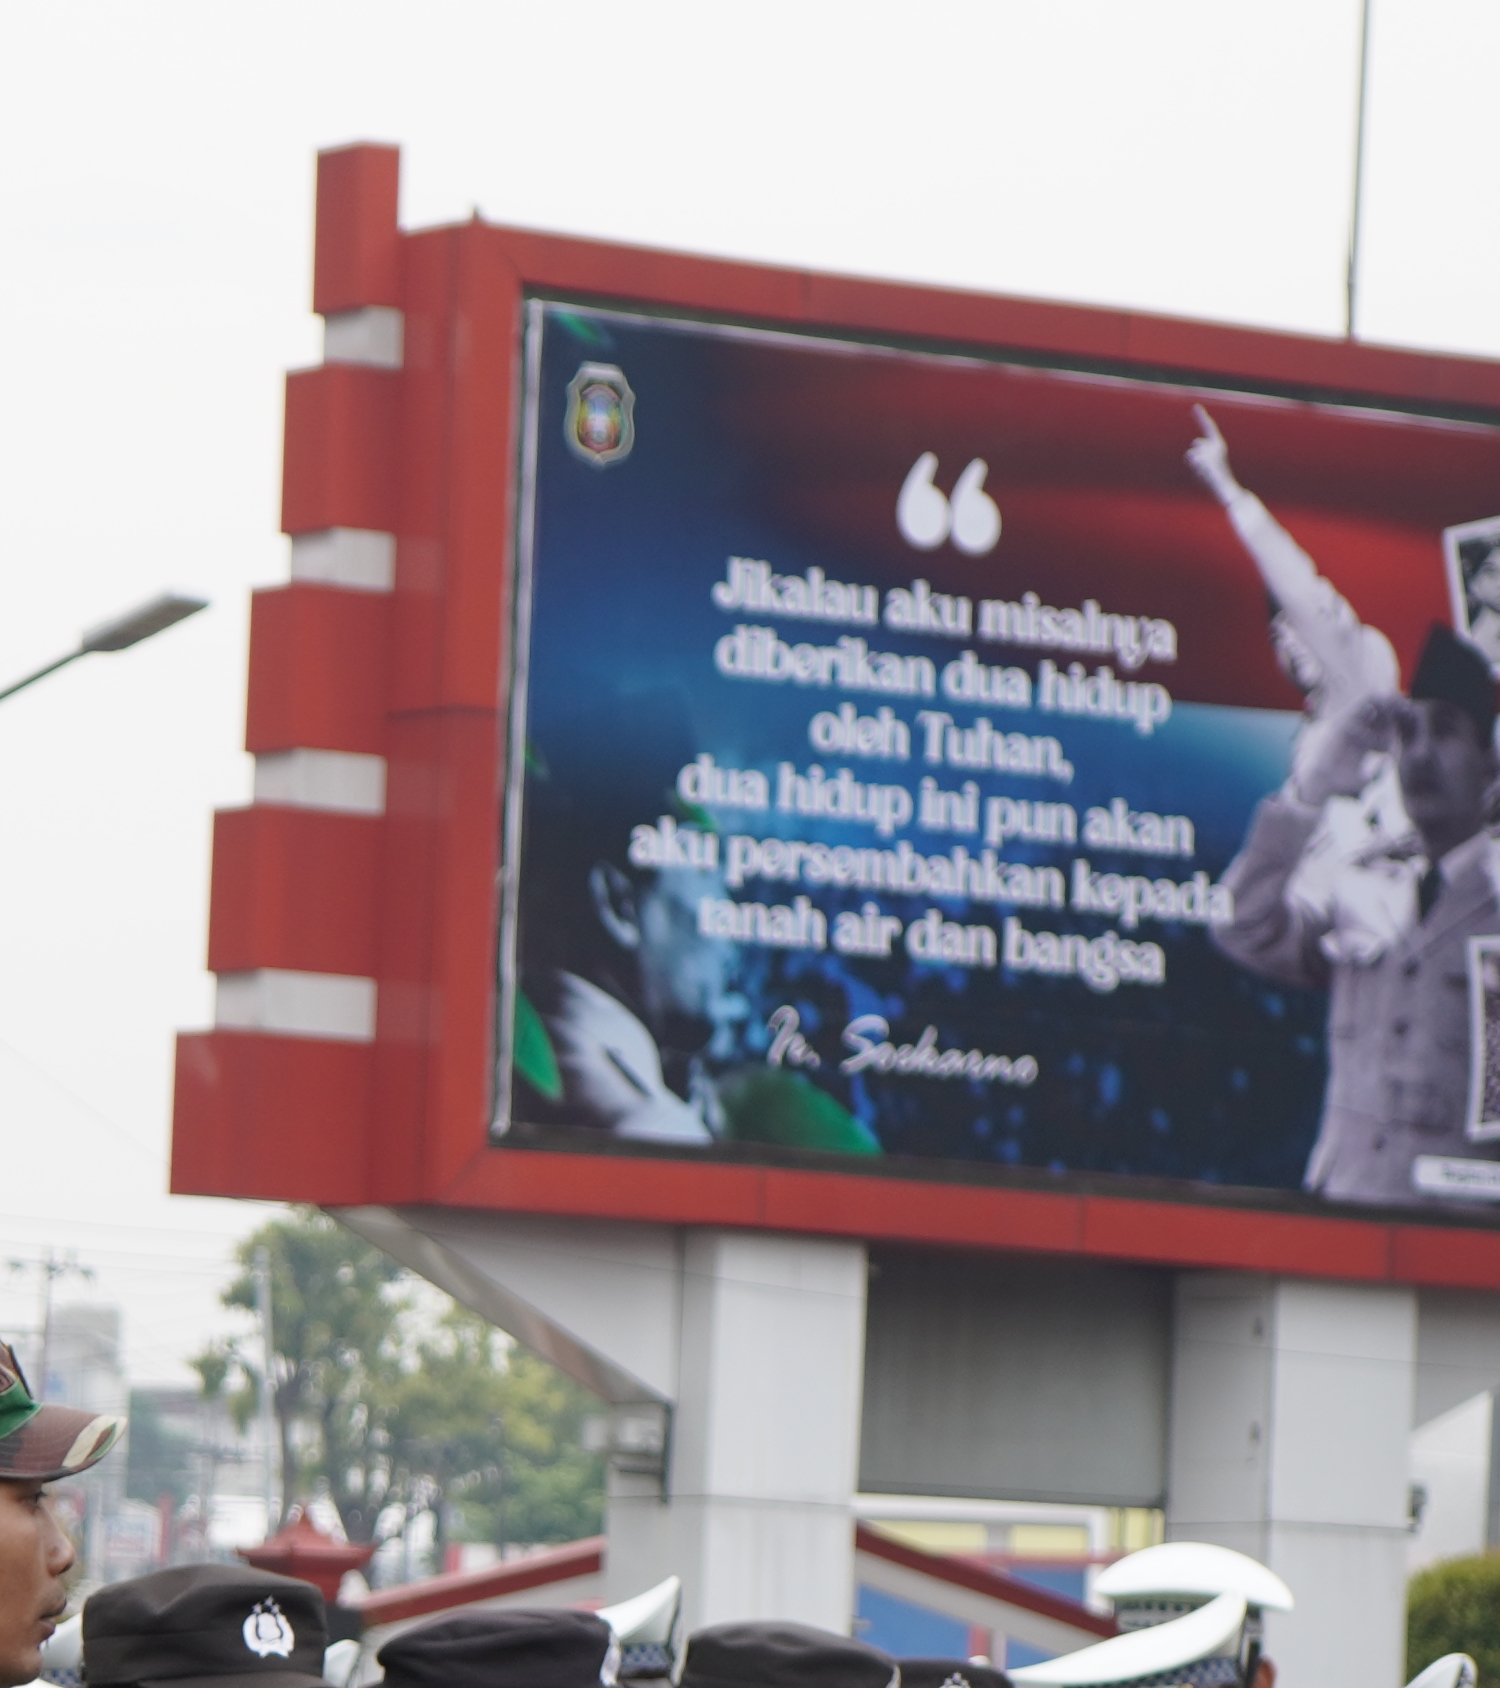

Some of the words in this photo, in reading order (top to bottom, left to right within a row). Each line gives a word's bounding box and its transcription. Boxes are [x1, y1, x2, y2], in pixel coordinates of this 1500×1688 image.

[710, 555, 880, 626] Jikalau
[883, 578, 973, 639] aku
[977, 590, 1179, 671] misalnya
[714, 624, 936, 697] diberikan
[942, 650, 1033, 709] dua
[1036, 659, 1173, 736] hidup
[808, 702, 911, 762] oleh
[914, 709, 1074, 784] Tuhan,
[676, 752, 769, 808] dua
[776, 761, 914, 837] hidup
[918, 775, 980, 834] ini
[986, 793, 1077, 845] pun
[1083, 797, 1196, 858] akan
[628, 815, 718, 871] aku
[724, 830, 1064, 911] persembahkan
[1071, 857, 1235, 929] kepada
[697, 895, 827, 953] tanah
[831, 902, 902, 958] air
[904, 907, 998, 968] dan
[1002, 916, 1167, 993] bangsa
